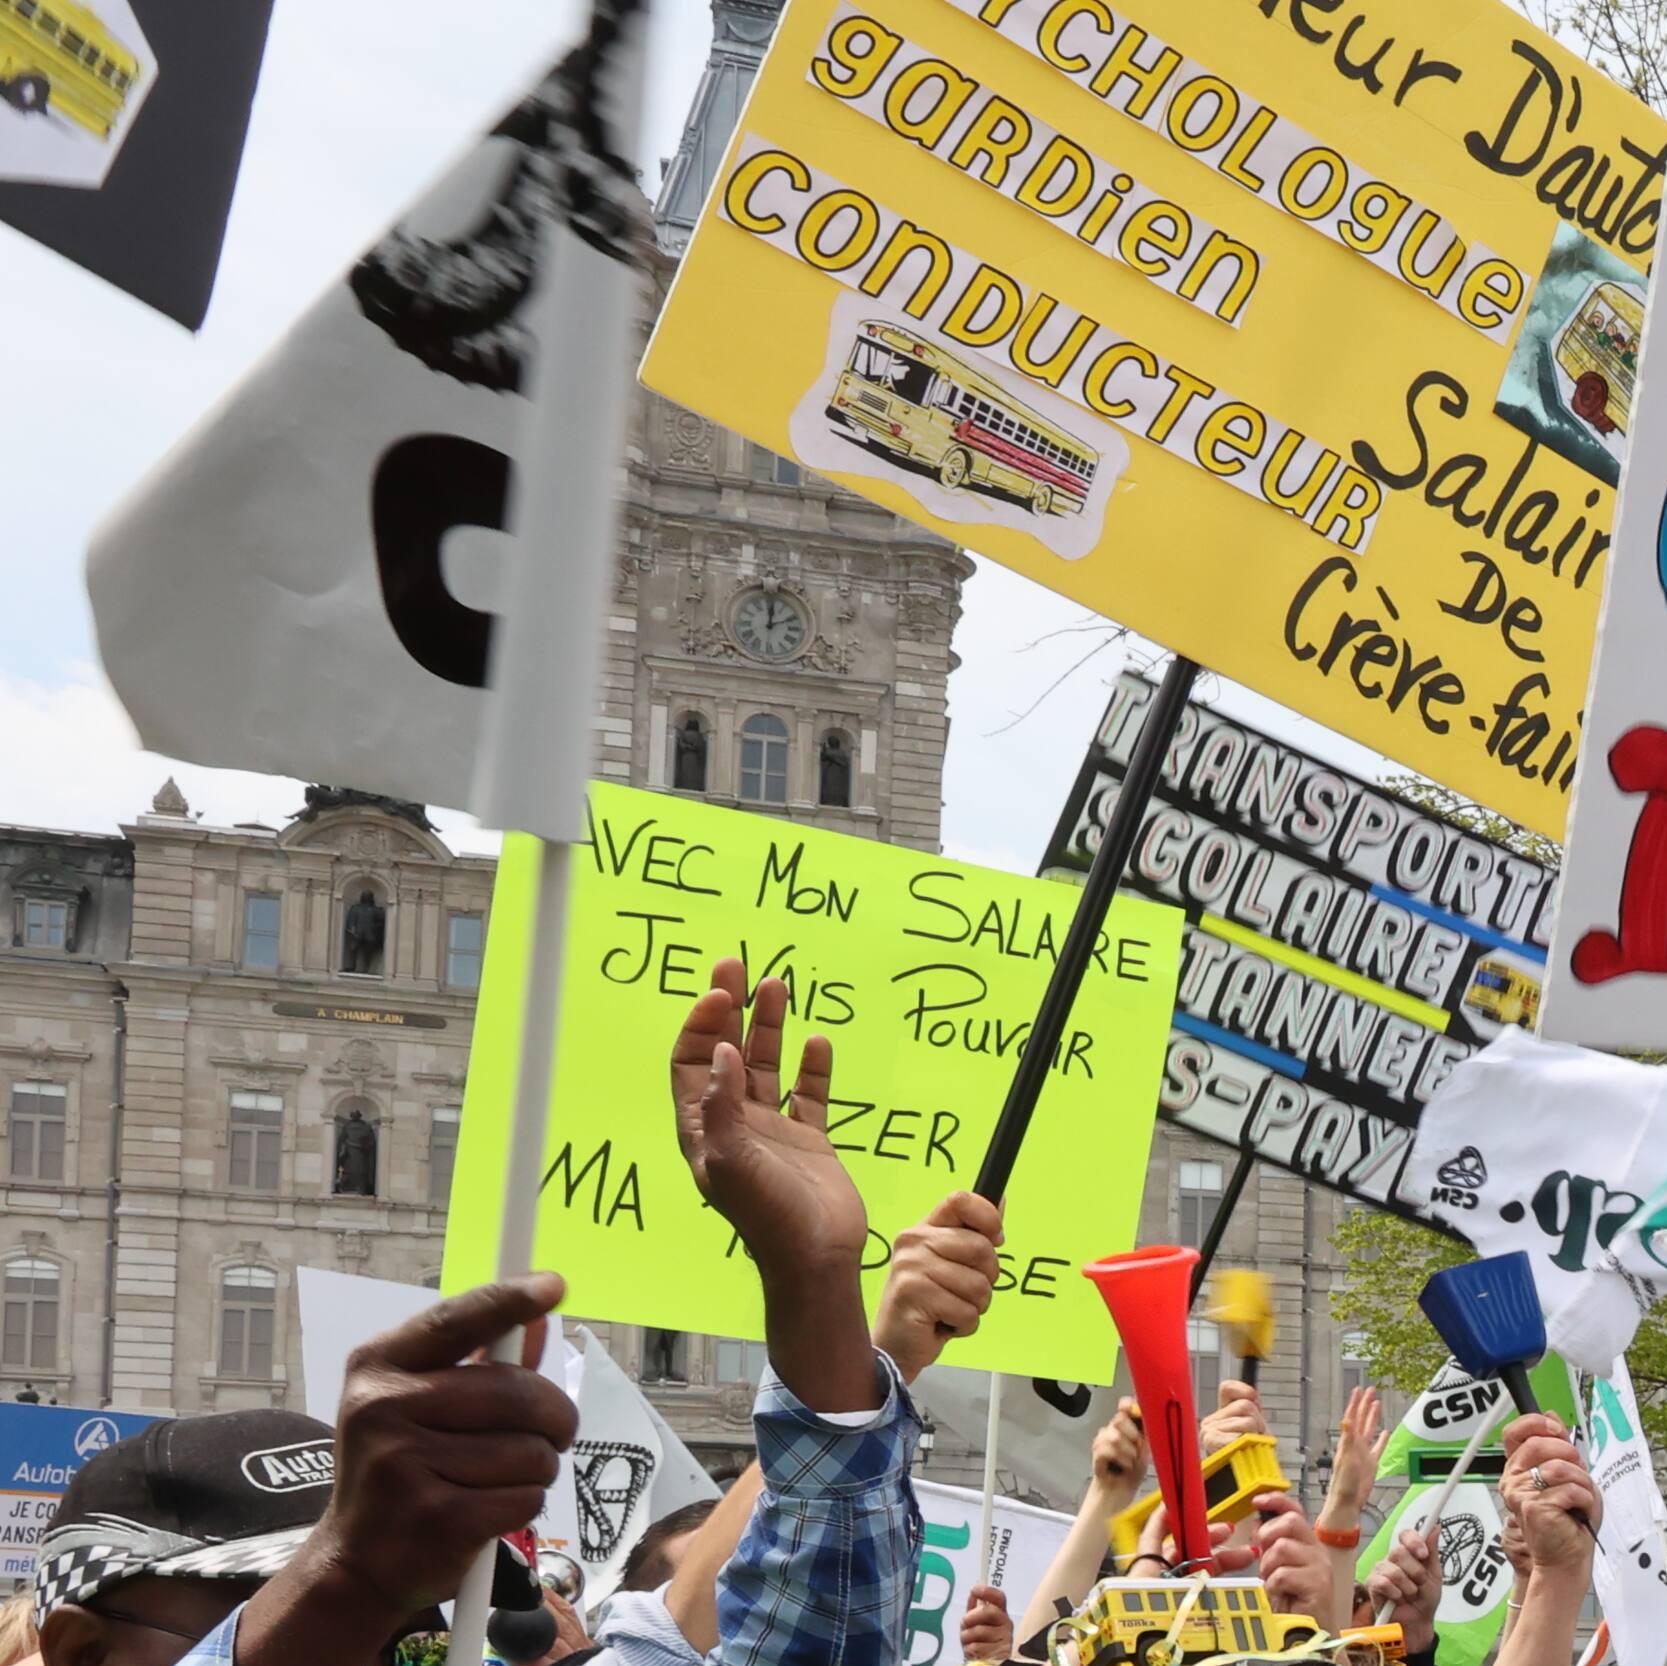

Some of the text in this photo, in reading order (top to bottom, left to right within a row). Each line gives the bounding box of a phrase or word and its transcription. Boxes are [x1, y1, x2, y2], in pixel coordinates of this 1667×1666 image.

[1256, 0, 1463, 107] eur
[1436, 551, 1545, 662] De
[600, 911, 703, 998] JE
[902, 871, 1152, 983] SALARE
[1161, 1036, 1426, 1205] S-PAY
[538, 1139, 645, 1232] MA
[1422, 1381, 1502, 1430] CSN
[9, 1500, 31, 1518] JE
[1462, 1533, 1508, 1607] CSN
